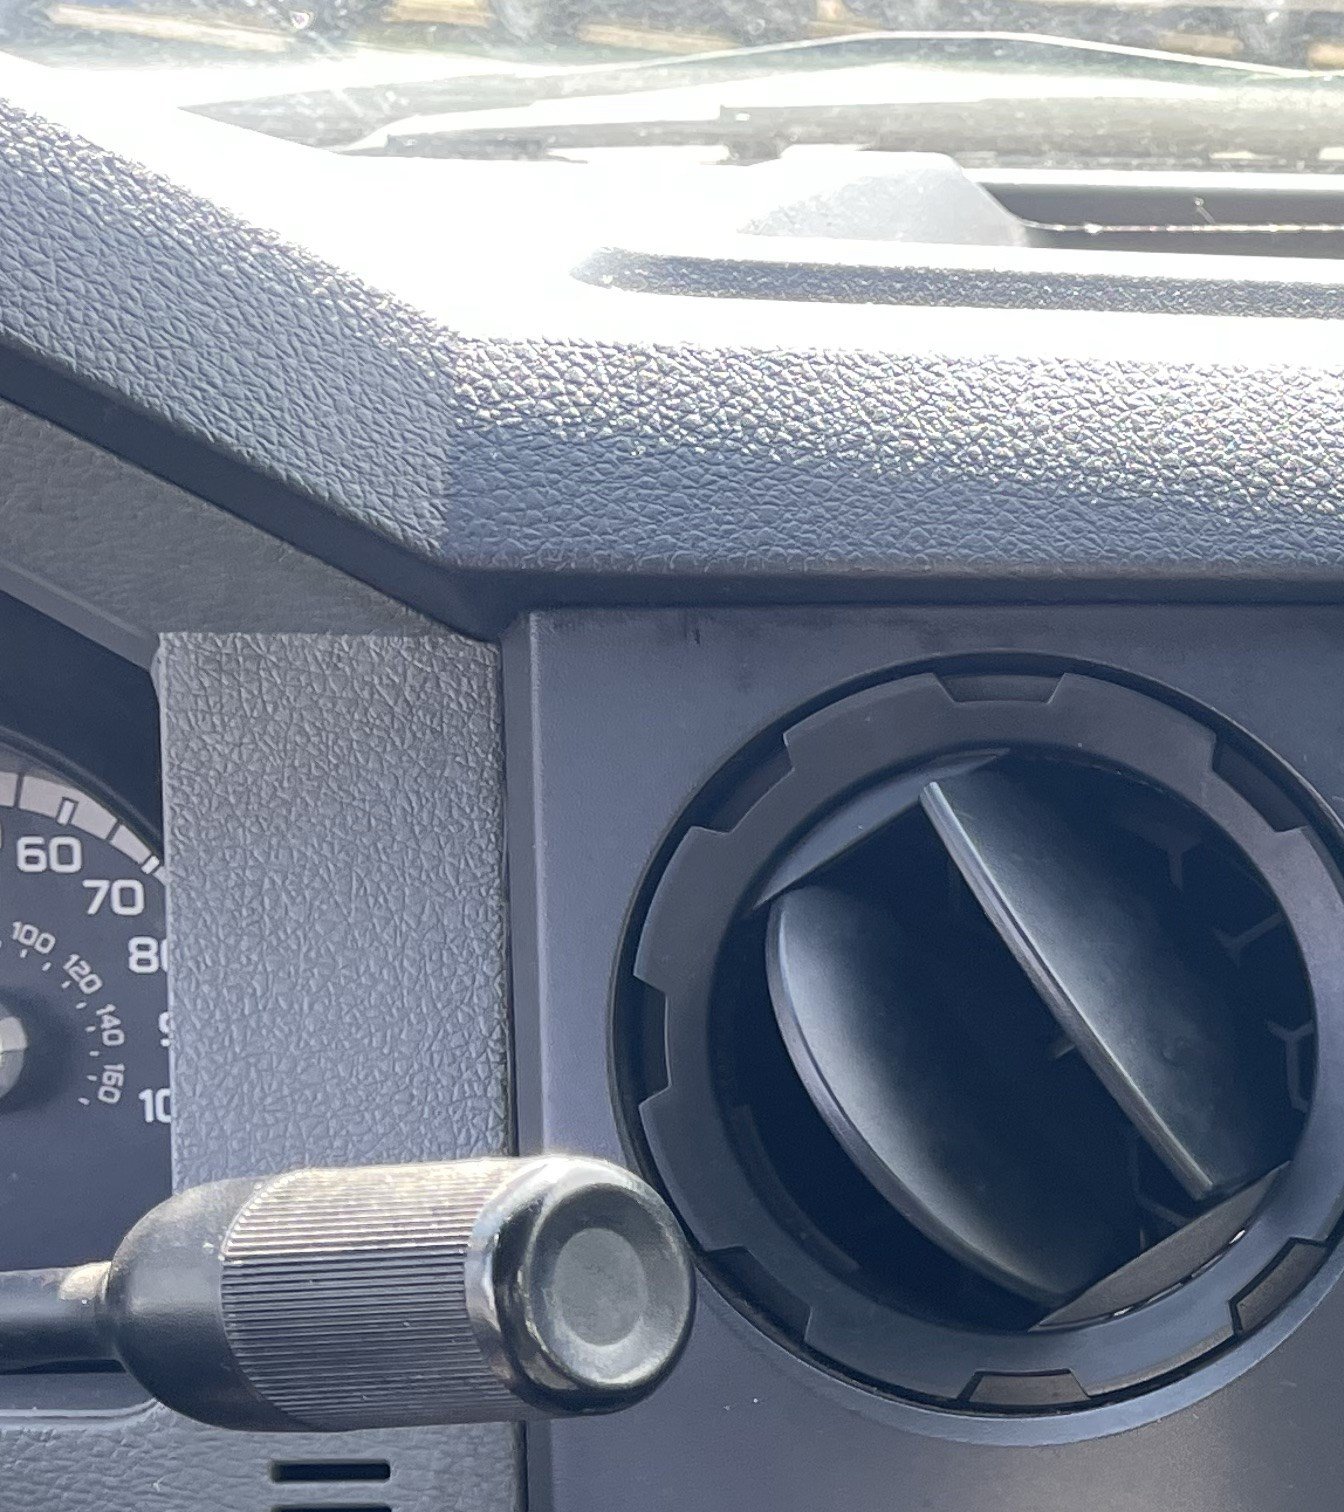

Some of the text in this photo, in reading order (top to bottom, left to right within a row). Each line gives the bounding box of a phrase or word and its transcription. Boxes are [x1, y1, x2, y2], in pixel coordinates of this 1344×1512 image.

[16, 836, 83, 873] 60
[82, 879, 145, 916] 70
[11, 920, 56, 955] 100
[62, 953, 102, 995] 120
[95, 1004, 125, 1047] 140
[98, 1063, 125, 1104] 160
